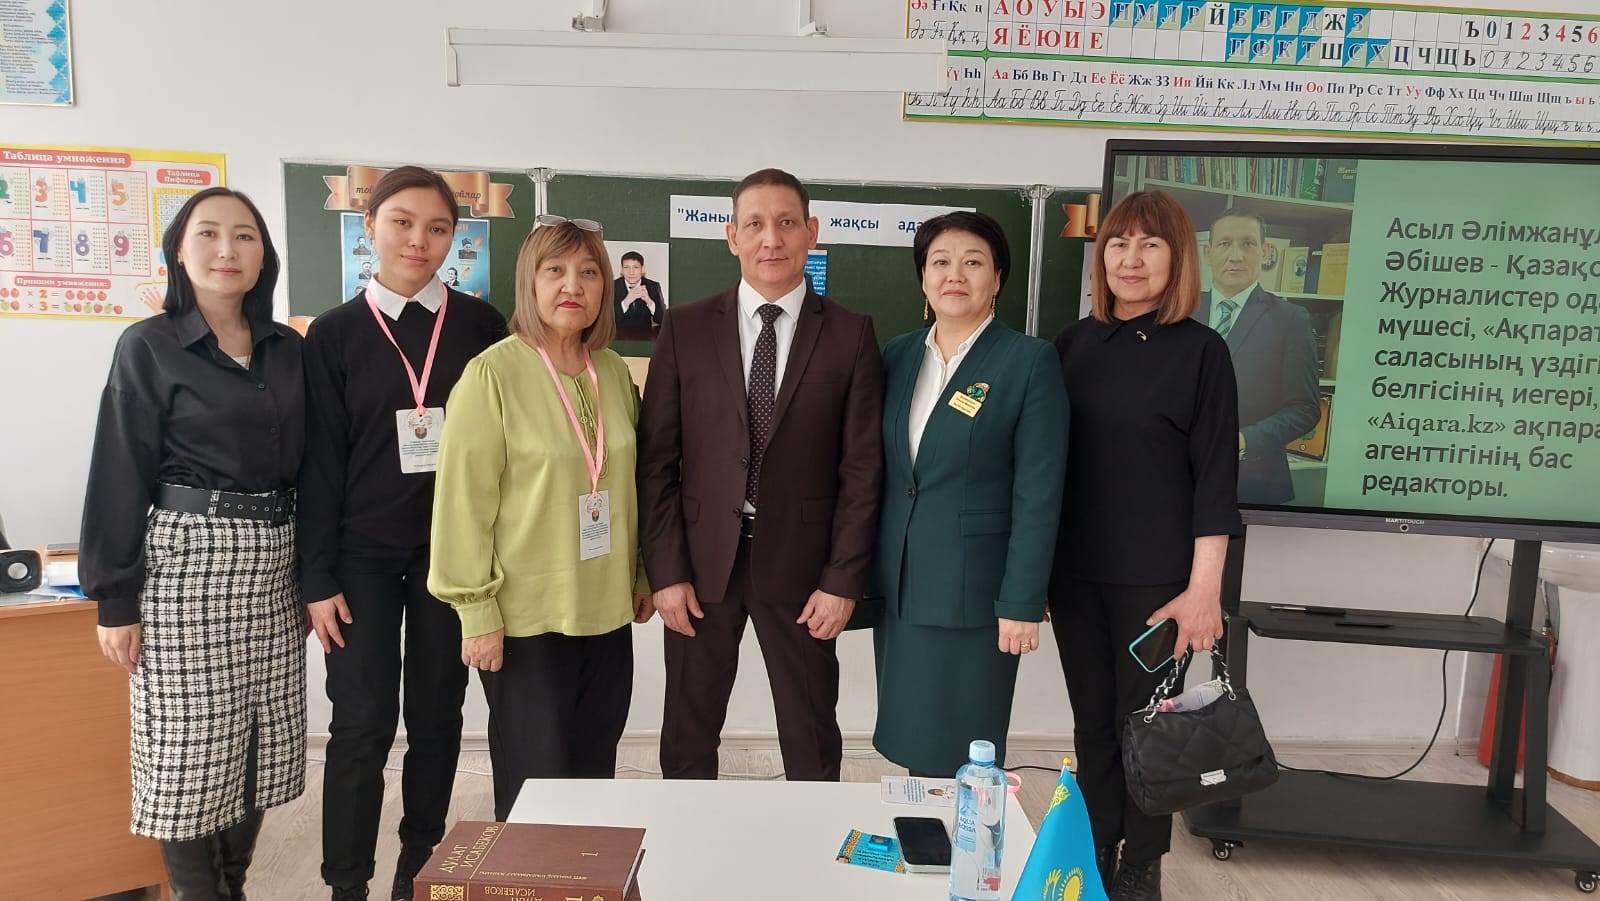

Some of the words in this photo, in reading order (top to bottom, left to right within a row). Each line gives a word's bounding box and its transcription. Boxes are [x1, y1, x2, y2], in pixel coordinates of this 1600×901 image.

[994, 0, 1009, 14] А
[1016, 0, 1033, 16] О
[1044, 0, 1058, 17] У
[1064, 0, 1085, 18] Ы
[1091, 2, 1105, 19] Э
[1113, 2, 1130, 21] Н
[1136, 3, 1154, 21] М
[1161, 5, 1178, 23] Л
[1187, 6, 1200, 24] Р
[1210, 4, 1224, 25] Й
[1234, 8, 1248, 27] Б
[1258, 9, 1272, 27] В
[1281, 10, 1295, 29] Г
[1302, 12, 1319, 32] Д
[1324, 14, 1345, 30] Ж
[1353, 14, 1363, 31] З
[1465, 21, 1479, 37] Ъ
[1487, 21, 1497, 38] 0
[1504, 22, 1513, 39] 1
[1521, 22, 1531, 40] 2
[1538, 23, 1550, 41] 3
[1555, 25, 1566, 42] 4
[1571, 26, 1583, 42] 5
[1588, 26, 1598, 43] 6
[993, 28, 1008, 45] Я
[1018, 25, 1031, 46] Ё
[1037, 29, 1060, 48] Ю
[1064, 31, 1080, 48] И
[1090, 32, 1103, 49] Е
[1230, 38, 1246, 56] П
[1253, 39, 1270, 57] Ф
[1277, 40, 1292, 58] К
[1302, 41, 1316, 58] Т
[1321, 43, 1343, 60] Ш
[1348, 44, 1362, 60] С
[1372, 44, 1385, 61] Х
[1394, 46, 1409, 67] Ц
[1418, 48, 1431, 64] Ч
[1436, 48, 1457, 72] Щ
[1464, 50, 1476, 66] Ь
[3, 151, 53, 161] Таблица
[57, 154, 125, 164] умножения
[35, 180, 48, 202] 3
[70, 180, 86, 203] 4
[111, 183, 127, 206] 5
[830, 215, 879, 231] жақсы
[1386, 217, 1453, 240] Асыл
[0, 231, 14, 256] 6
[33, 230, 49, 253] 7
[76, 234, 90, 256] 8
[113, 235, 129, 256] 9
[1385, 249, 1484, 273] Әбішев
[1379, 281, 1559, 313] Журналистер
[1378, 317, 1476, 340] мүшесі,
[1374, 349, 1523, 376] саласының
[1371, 376, 1503, 407] белгісінің
[1512, 386, 1598, 411] иегері,
[1367, 412, 1506, 436] «Aiqara.kz»
[1365, 443, 1521, 471] агенттігінің
[1529, 445, 1573, 469] бас
[1362, 474, 1508, 500] редакторы.
[460, 825, 499, 868] ИСАБЕКОВ
